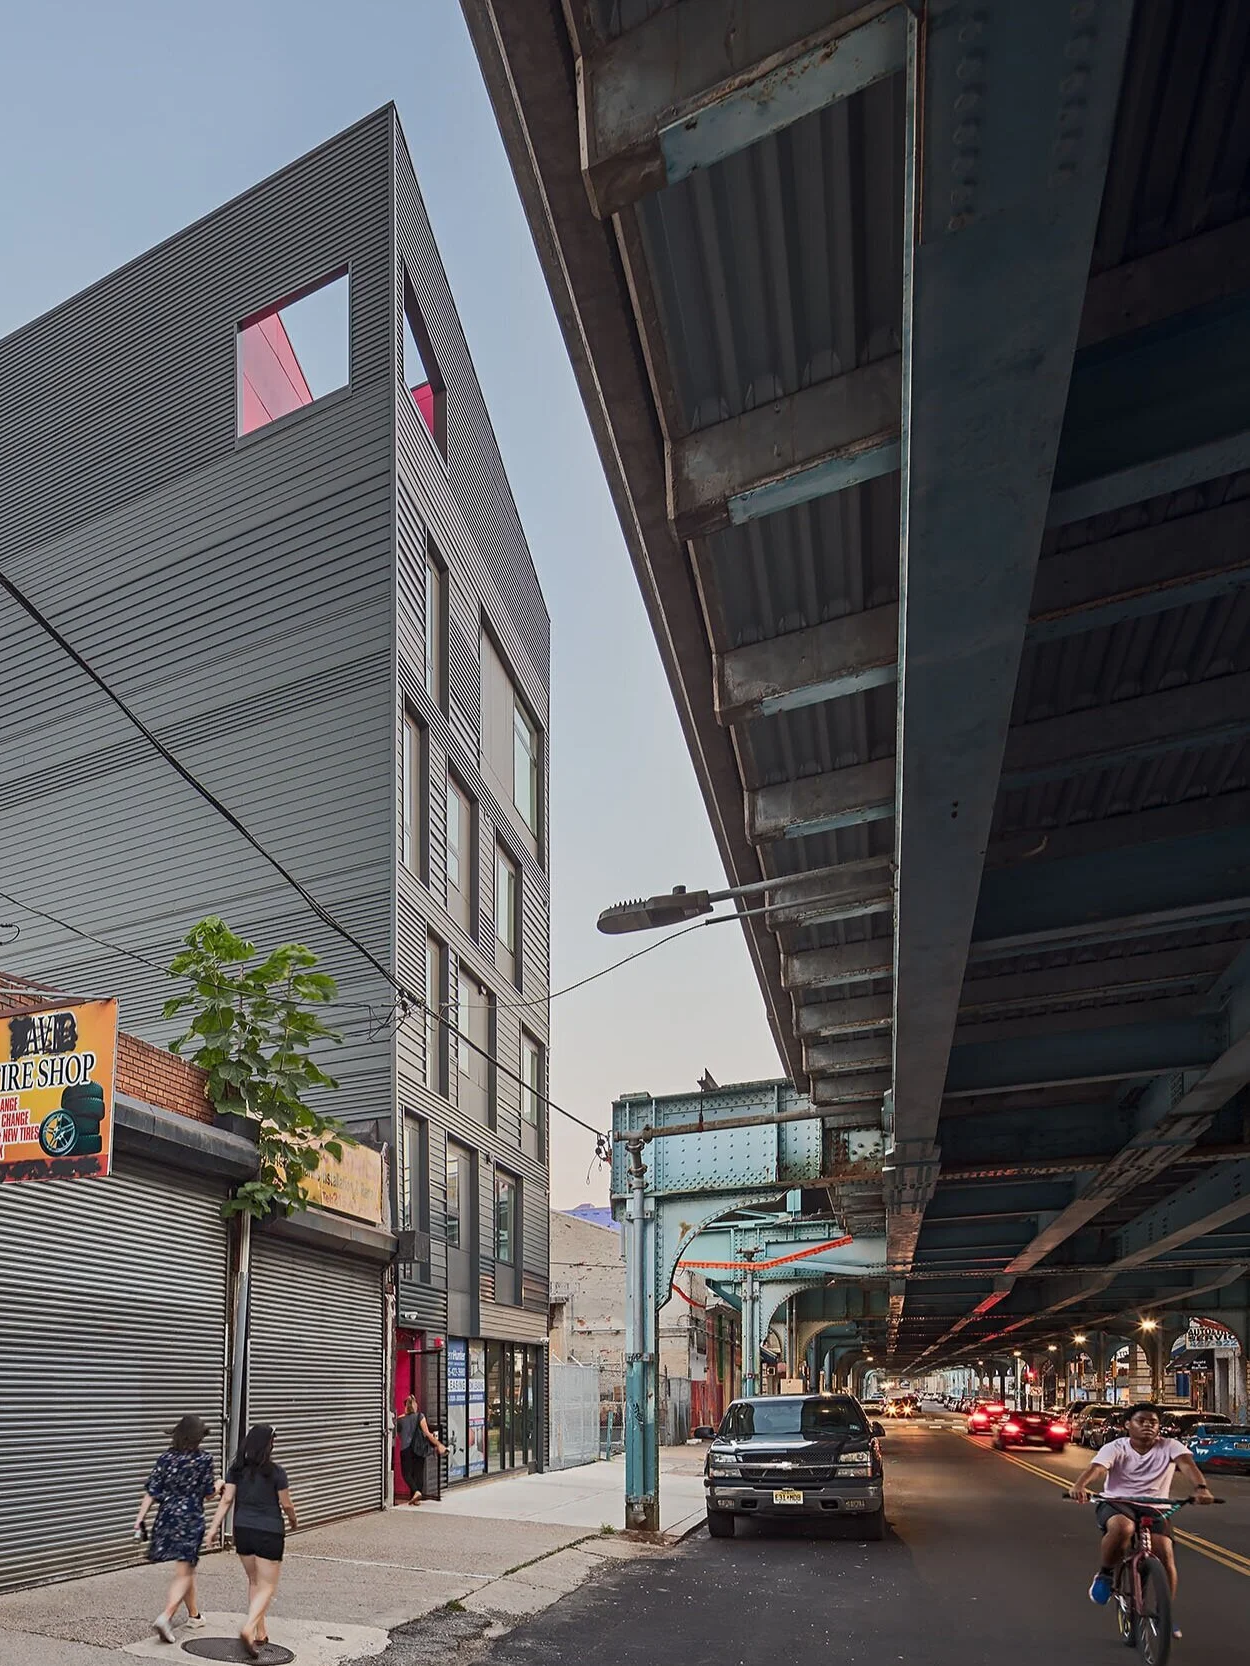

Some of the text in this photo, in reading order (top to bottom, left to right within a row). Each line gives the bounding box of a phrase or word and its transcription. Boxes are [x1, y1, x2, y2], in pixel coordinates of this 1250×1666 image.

[37, 1053, 94, 1088] SHOP
[1, 1111, 29, 1127] CHANGE
[2, 1128, 18, 1142] NEW
[20, 1126, 40, 1140] TIRES
